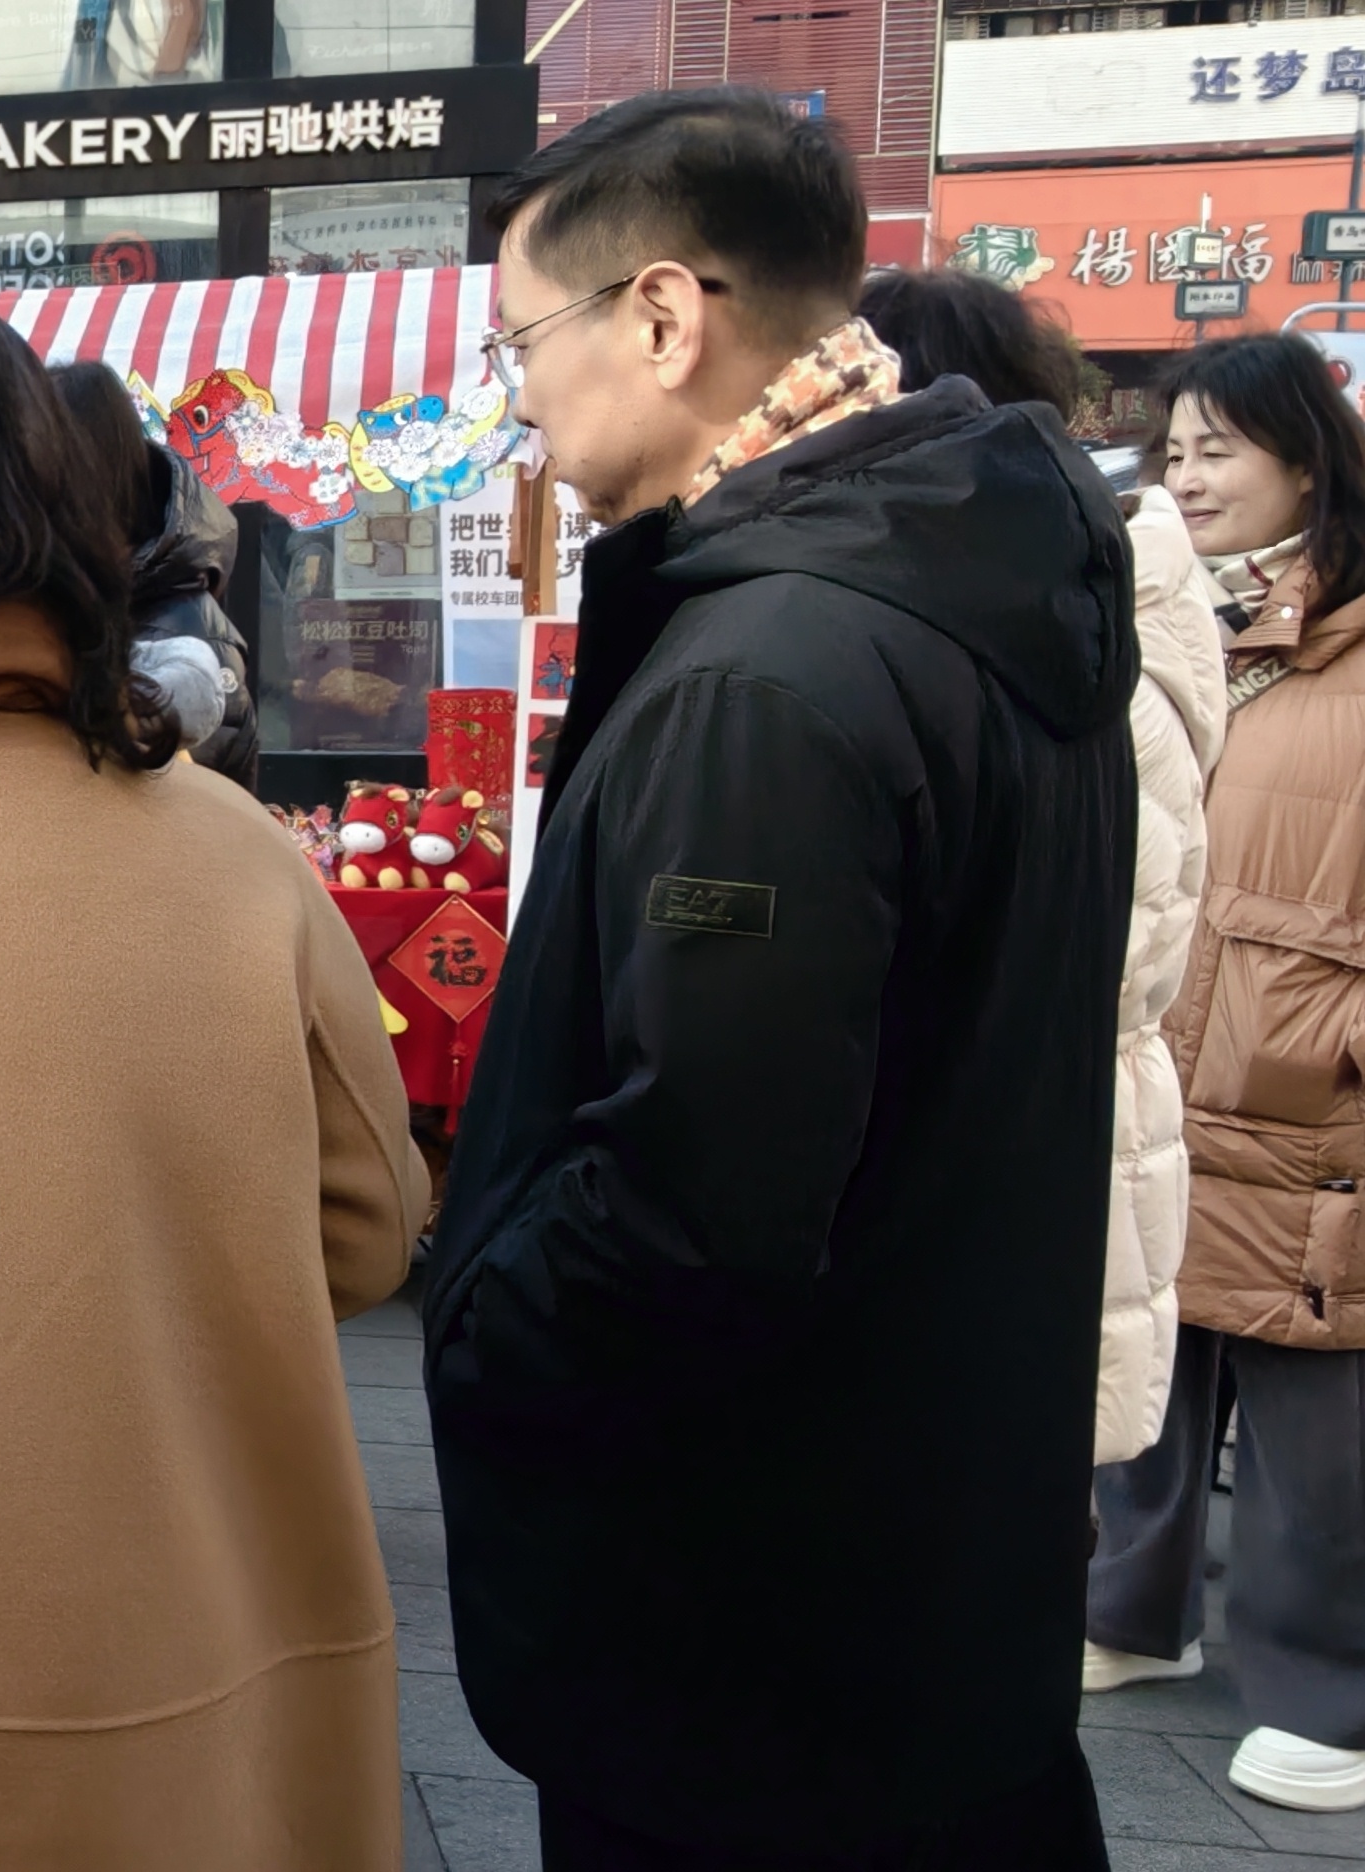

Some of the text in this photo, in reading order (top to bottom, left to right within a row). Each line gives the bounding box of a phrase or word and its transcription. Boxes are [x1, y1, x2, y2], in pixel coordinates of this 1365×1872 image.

[1189, 46, 1365, 104] 还梦岛
[208, 95, 445, 161] 丽驰烘焙
[450, 590, 524, 606] 专属校车团
[424, 932, 488, 987] 福
